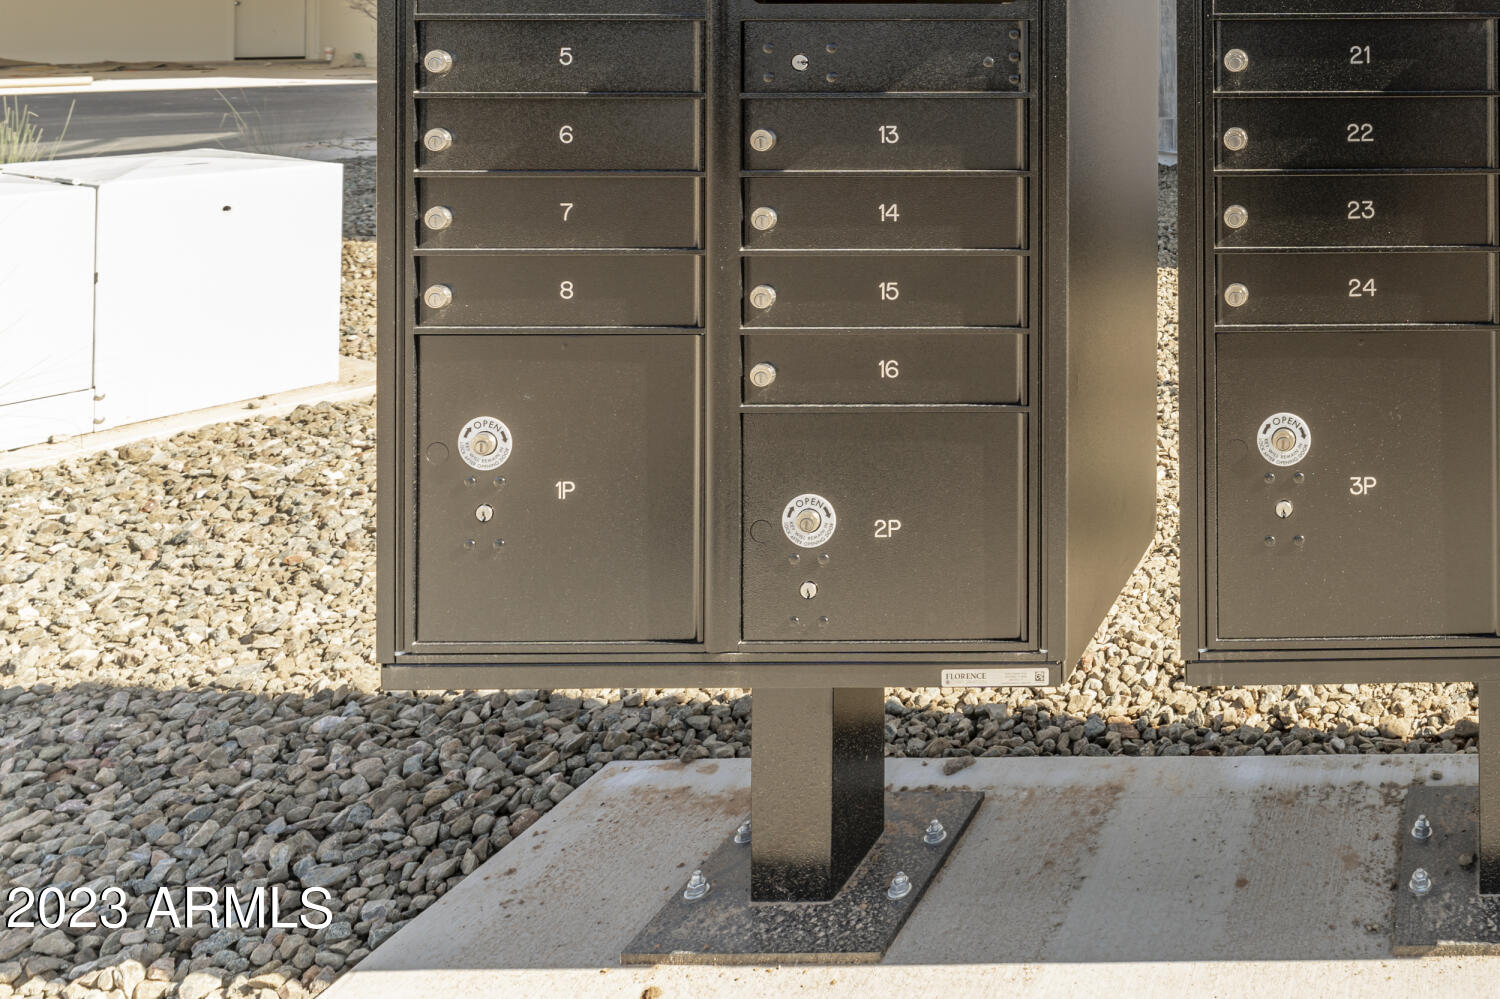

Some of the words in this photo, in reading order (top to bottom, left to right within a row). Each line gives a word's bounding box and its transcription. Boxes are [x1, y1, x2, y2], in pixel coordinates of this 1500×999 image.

[559, 47, 573, 66] 5
[1349, 45, 1371, 65] 21
[559, 125, 574, 144] 6
[878, 125, 900, 144] 13
[1346, 123, 1375, 142] 22
[559, 202, 574, 222] 7
[878, 203, 900, 222] 14
[1347, 200, 1375, 220] 23
[559, 280, 574, 300] 8
[878, 281, 900, 301] 15
[1348, 278, 1377, 298] 24
[878, 359, 899, 379] 16
[473, 420, 502, 432] OPEN
[1272, 416, 1301, 428] OPEN
[555, 480, 576, 500] 1P
[1349, 476, 1377, 496] 3P
[795, 498, 824, 508] OPEN
[874, 519, 902, 538] 2P
[945, 672, 987, 680] FLORENCE
